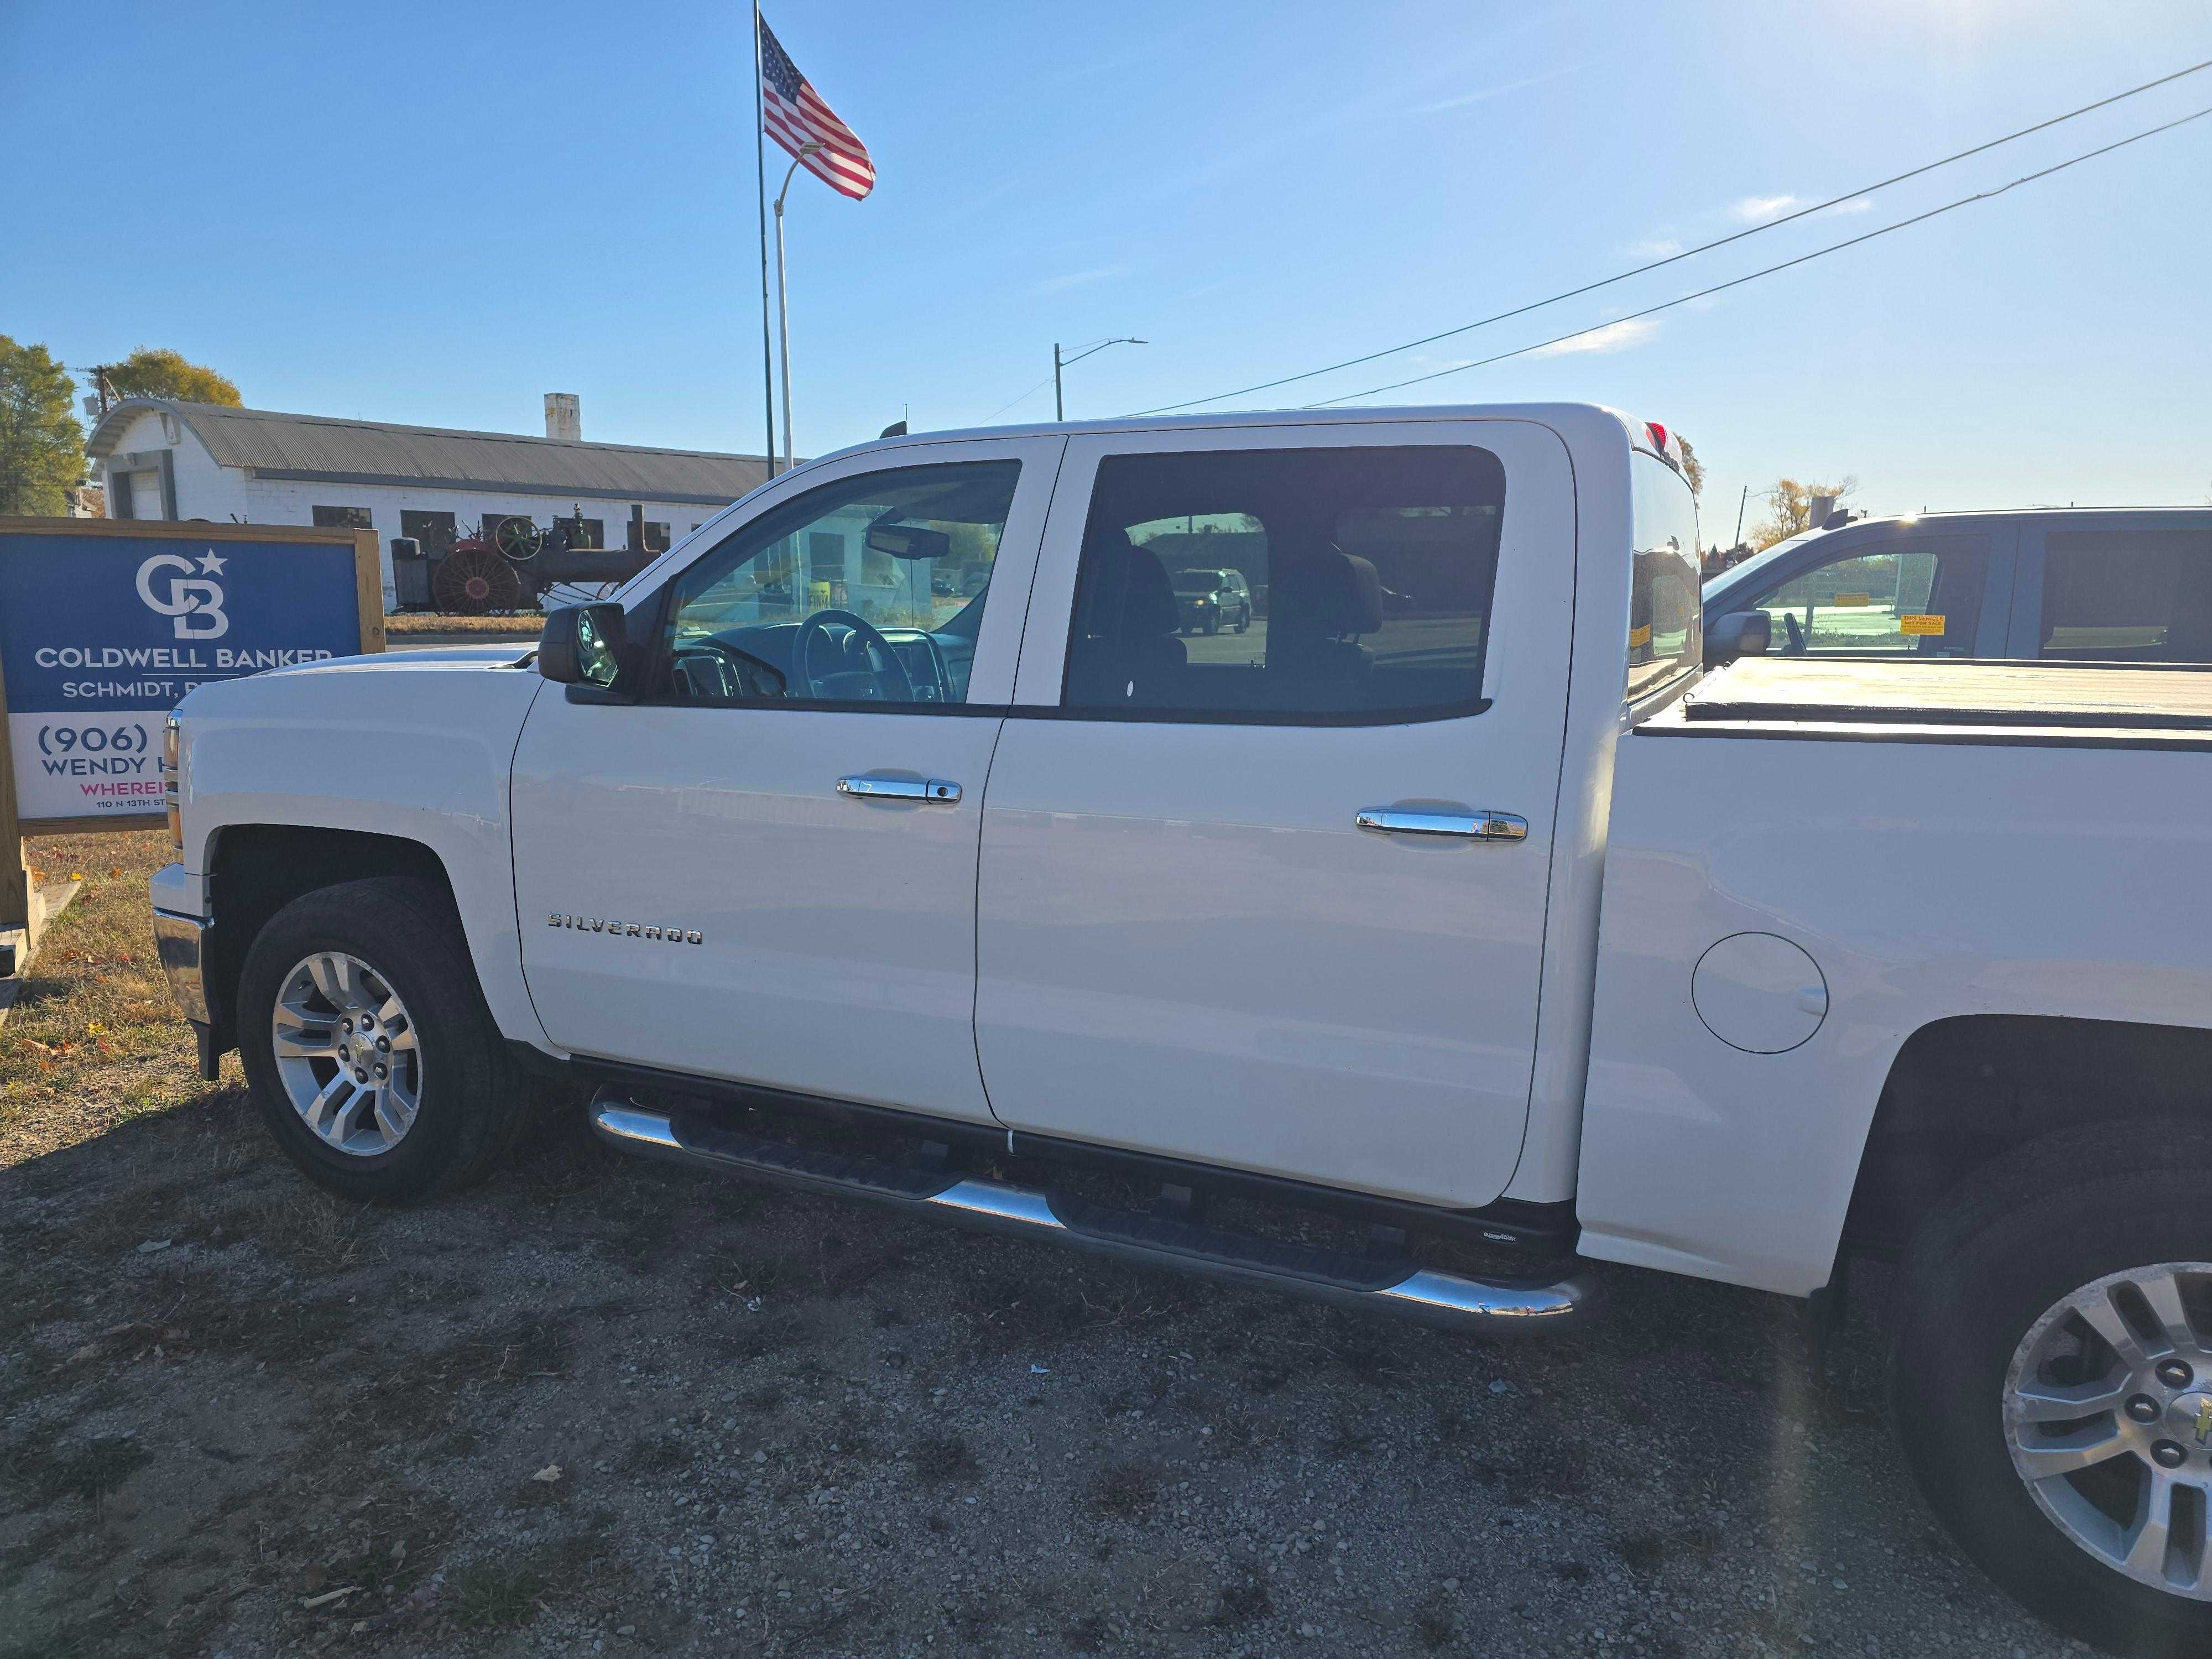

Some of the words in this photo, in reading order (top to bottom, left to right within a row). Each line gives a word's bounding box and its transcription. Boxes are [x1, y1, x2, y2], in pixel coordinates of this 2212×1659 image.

[35, 648, 207, 667] COLDWELL
[62, 682, 179, 698] SCHMIDT,
[38, 723, 147, 756] (906)
[41, 757, 147, 775] WENDY
[548, 913, 703, 945] SILVERADO
